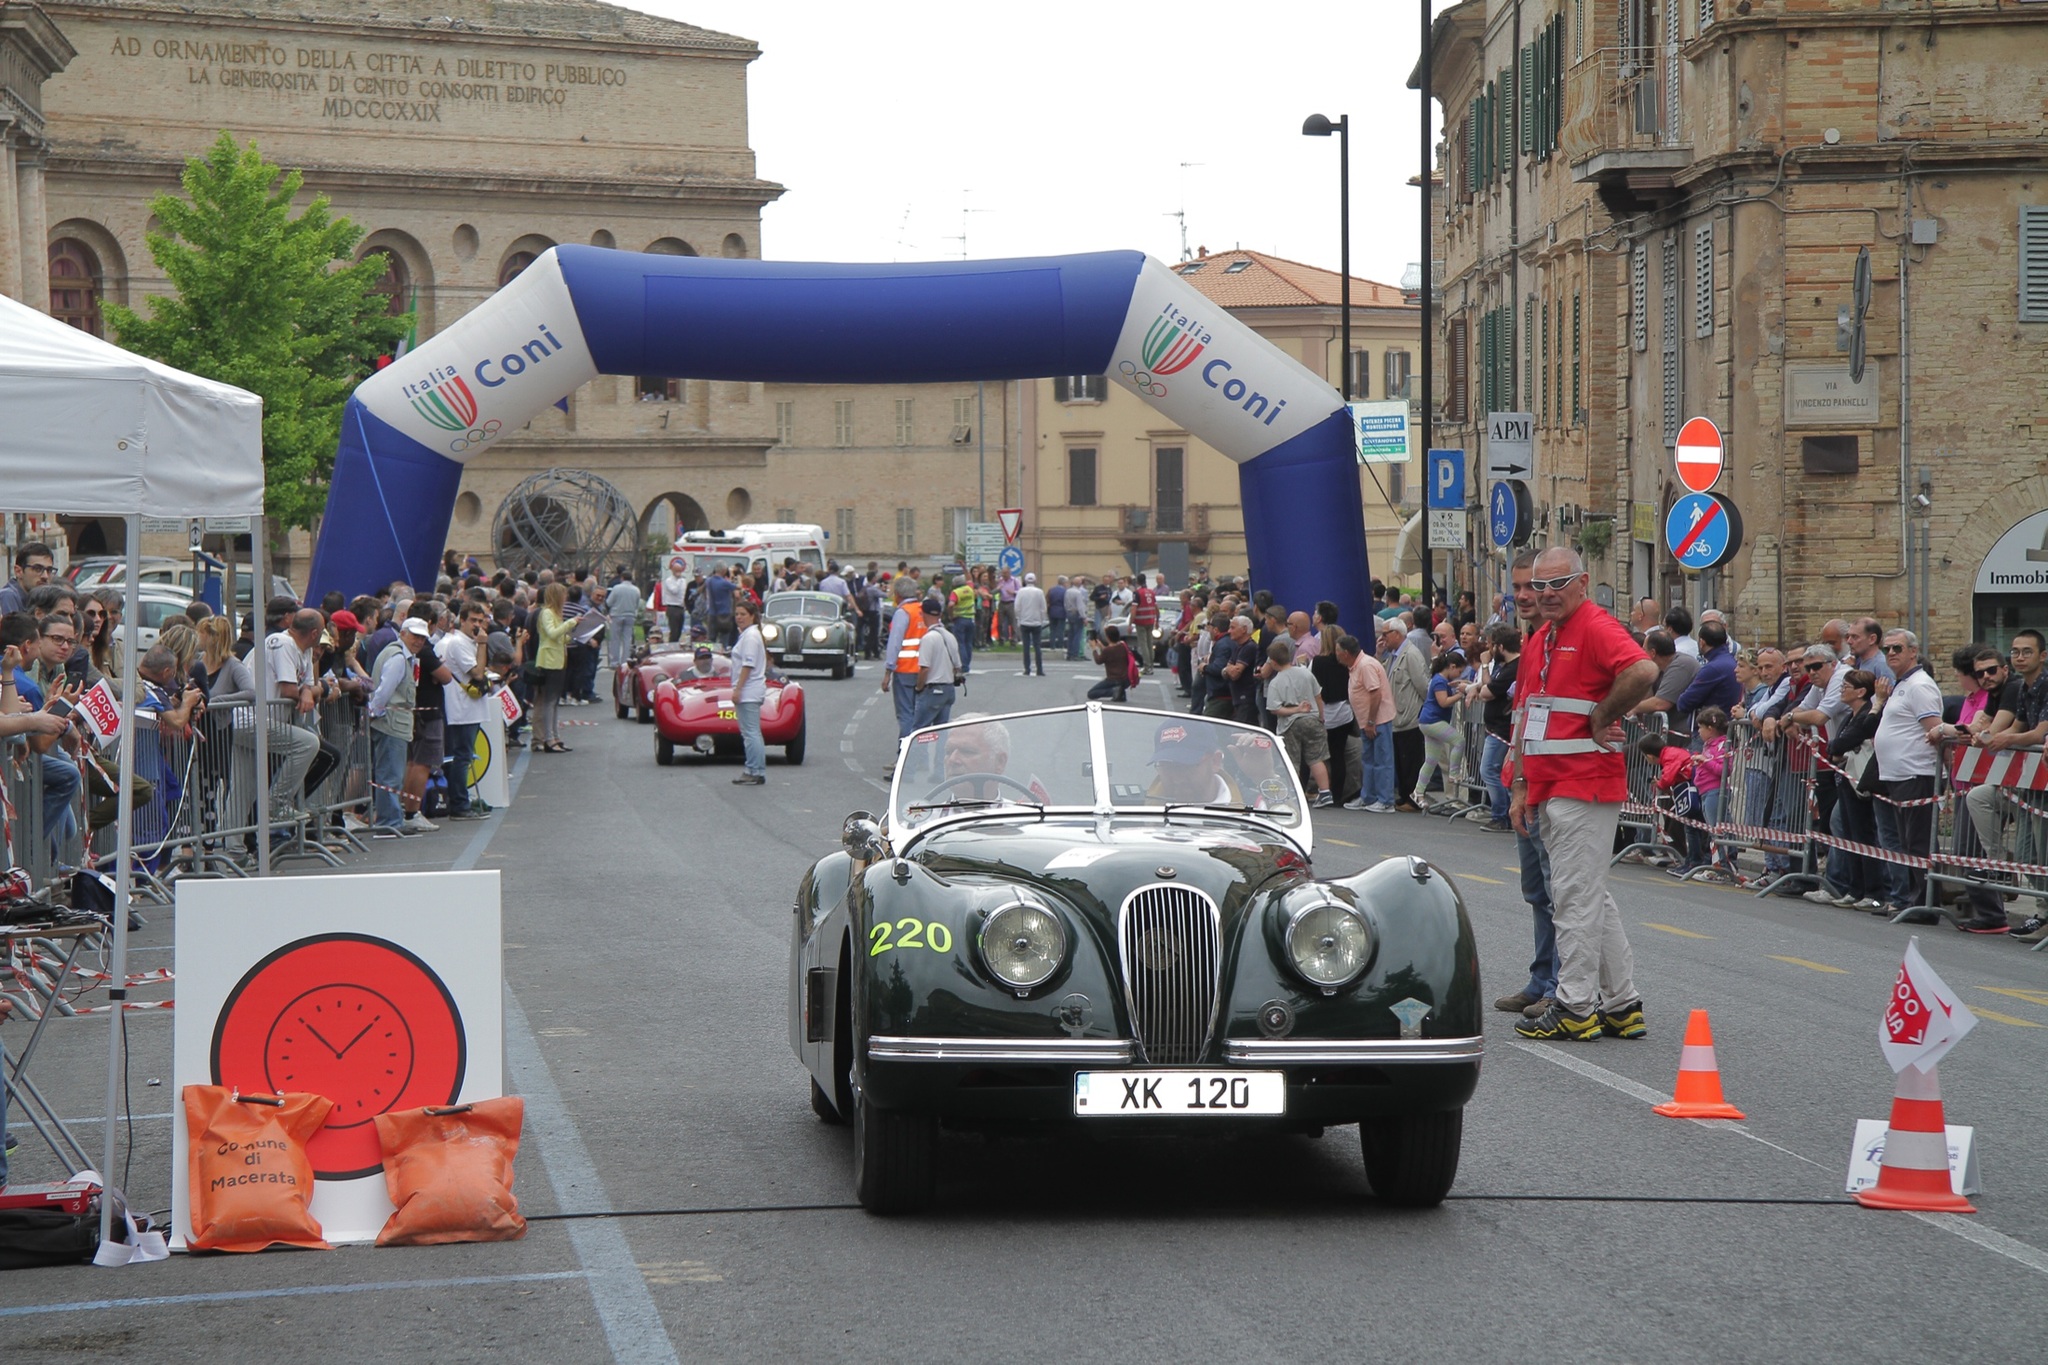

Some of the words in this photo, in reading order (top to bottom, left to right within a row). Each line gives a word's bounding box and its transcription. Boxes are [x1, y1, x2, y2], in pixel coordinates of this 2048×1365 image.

[111, 37, 141, 56] AD
[153, 39, 286, 66] ORNAMENTO
[298, 50, 356, 70] DELLA
[434, 58, 447, 76] A
[457, 59, 536, 81] DILETTO
[545, 64, 626, 86] PUBBLICO
[189, 67, 210, 84] LA
[328, 75, 344, 92] DI
[354, 76, 409, 97] CENTO
[419, 81, 498, 102] CONSORTI
[322, 98, 442, 122] MDCCCXXIX
[1163, 302, 1212, 345] Italia
[474, 324, 562, 388] Coni
[402, 365, 457, 398] Italia
[1202, 358, 1287, 426] Coni
[1825, 382, 1838, 390] VIA
[1795, 398, 1832, 408] VINCENZO
[1833, 398, 1869, 407] PANNELLI
[1491, 421, 1529, 440] APM
[1438, 459, 1454, 499] P
[82, 696, 108, 731] MIGLIA
[94, 690, 115, 720] 1000
[869, 916, 952, 957] 220
[1120, 1077, 1163, 1109] XK
[1187, 1077, 1250, 1109] 120
[217, 1139, 288, 1156] Comune
[244, 1152, 261, 1166] di
[211, 1172, 296, 1192] Macerata
